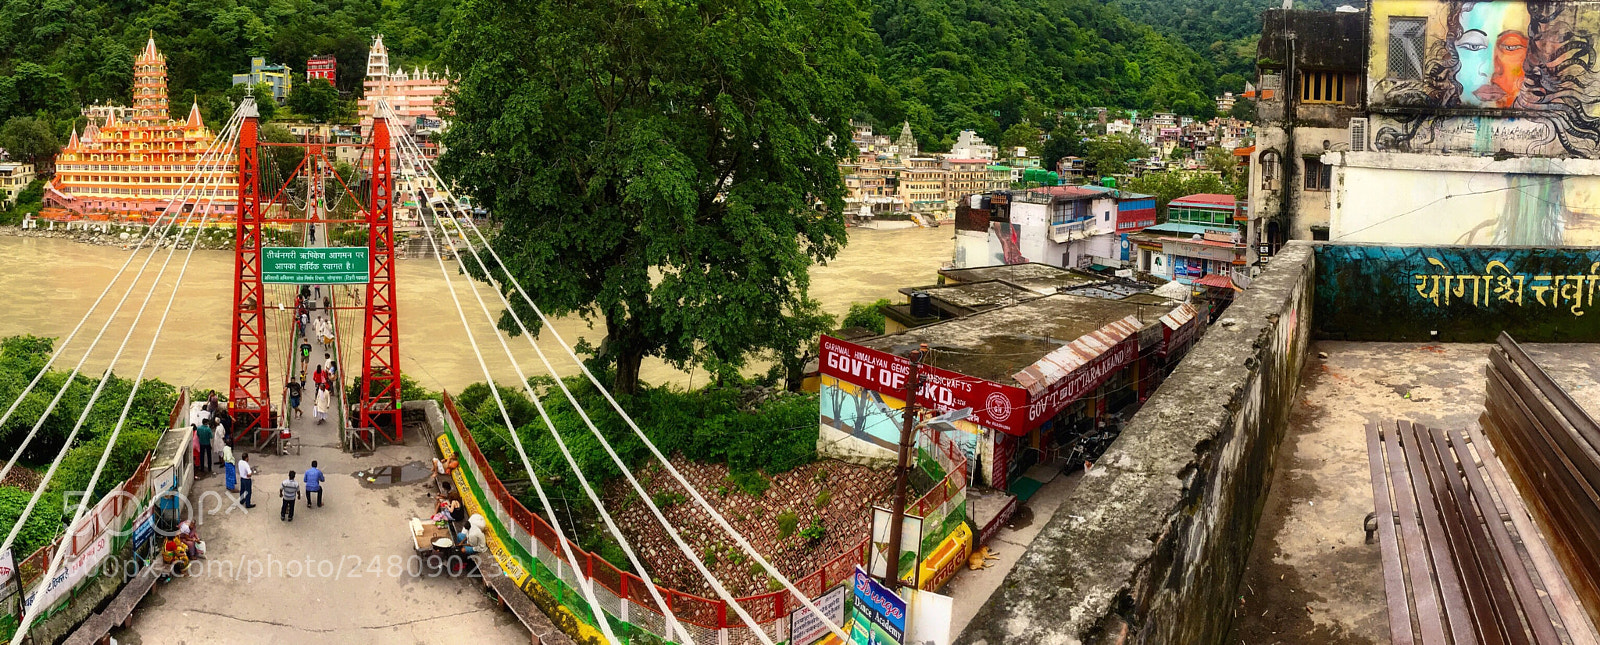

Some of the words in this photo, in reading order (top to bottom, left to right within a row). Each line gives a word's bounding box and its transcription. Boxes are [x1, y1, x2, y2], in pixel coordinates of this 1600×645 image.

[266, 250, 296, 260] तीर्थनगरी
[300, 250, 326, 260] ऋषिकेश
[329, 251, 352, 259] आगमन
[355, 251, 364, 259] पर
[275, 262, 296, 270] आपका
[300, 261, 320, 270] हार्दिक
[323, 262, 343, 270] स्वागत
[825, 342, 851, 357] GARHWAL
[854, 350, 888, 369] HIMALAYAN
[891, 362, 910, 376] GEMS
[827, 351, 874, 382] GOVT.
[879, 368, 906, 389] OF
[856, 572, 904, 620] Durga
[854, 597, 873, 618] Dance
[874, 612, 902, 642] Academy
